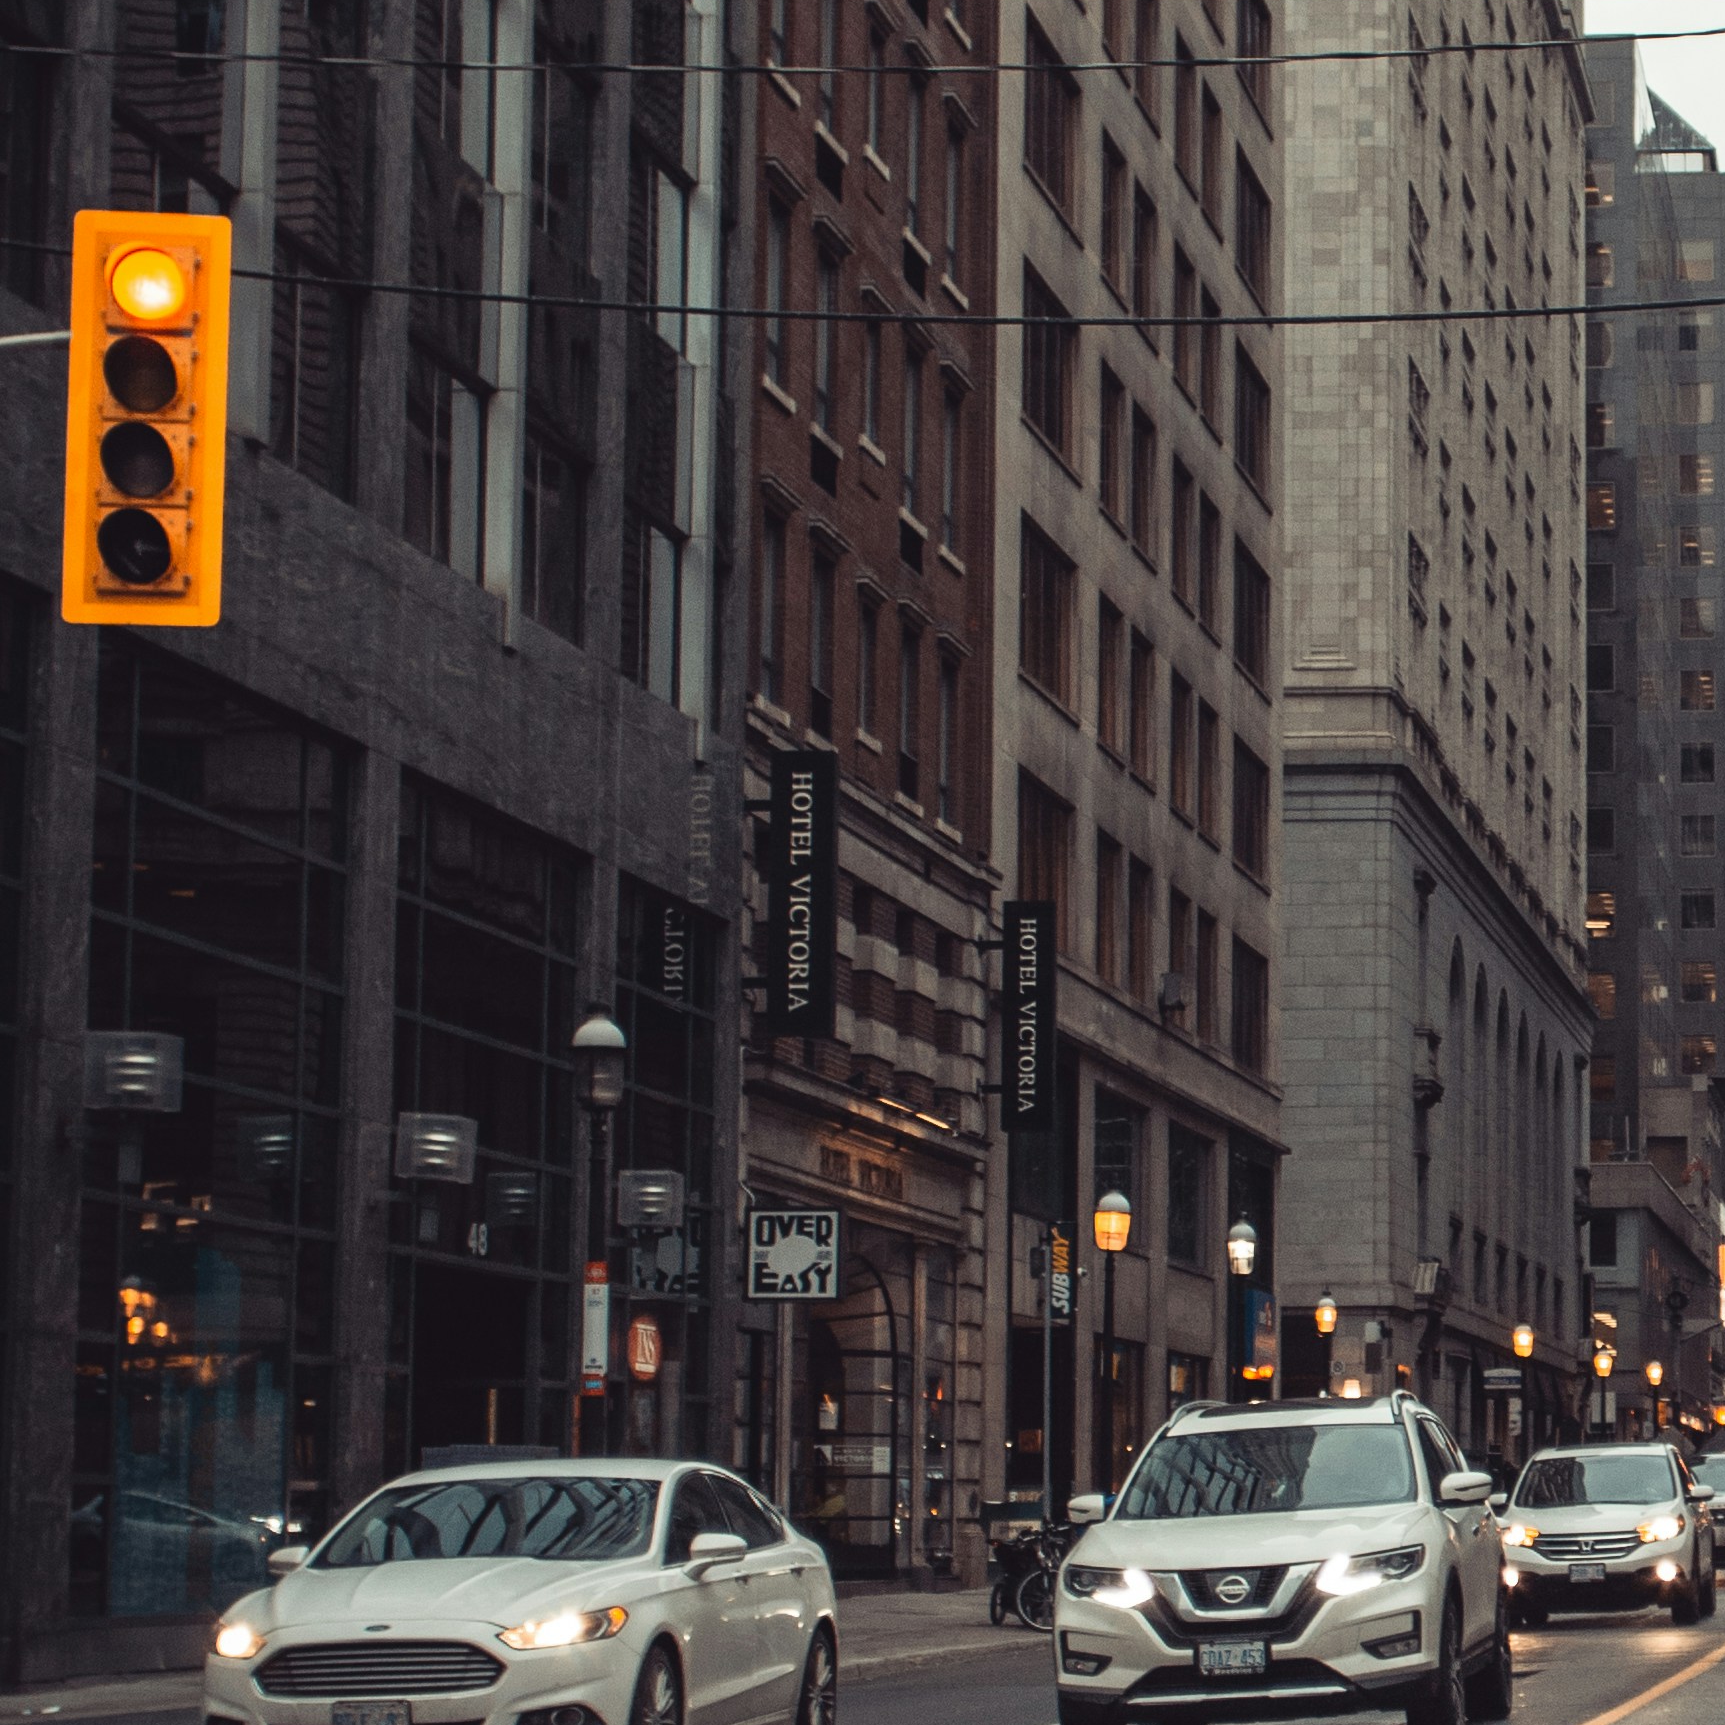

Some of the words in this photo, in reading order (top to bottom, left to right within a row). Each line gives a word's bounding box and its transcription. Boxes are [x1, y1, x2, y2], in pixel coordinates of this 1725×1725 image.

[790, 771, 813, 866] HOTEL
[787, 873, 812, 1013] VICTORIA
[1018, 917, 1038, 994] HOTEL
[1017, 1001, 1037, 1114] VICTORIA
[467, 1221, 488, 1257] 48
[755, 1215, 833, 1247] OVER
[1050, 1226, 1070, 1315] SUBWAY
[754, 1261, 832, 1293] EASY
